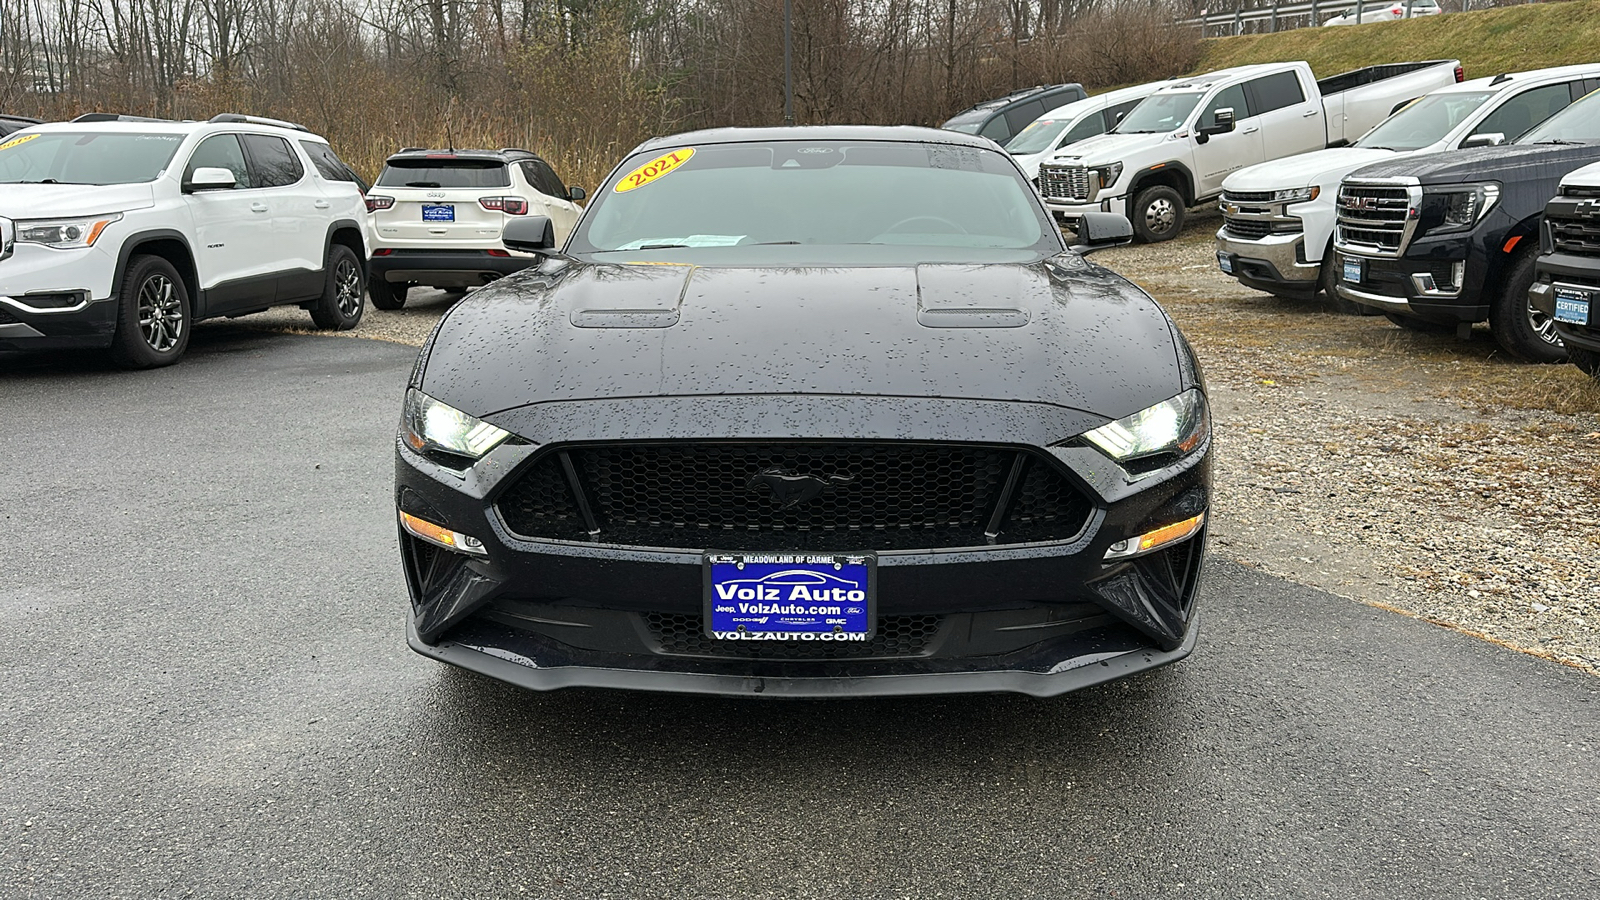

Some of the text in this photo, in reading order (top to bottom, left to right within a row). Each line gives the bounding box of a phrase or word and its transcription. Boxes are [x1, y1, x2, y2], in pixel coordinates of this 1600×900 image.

[629, 152, 683, 186] 2021
[1556, 301, 1589, 313] CERTIFIED
[743, 555, 794, 564] MEADOWLAND
[795, 555, 805, 564] OF
[806, 555, 836, 564] CARMEL
[714, 584, 865, 602] Volz Auto
[738, 603, 841, 615] VolzAuto.com
[713, 631, 866, 642] VOLZAUTO.COM
